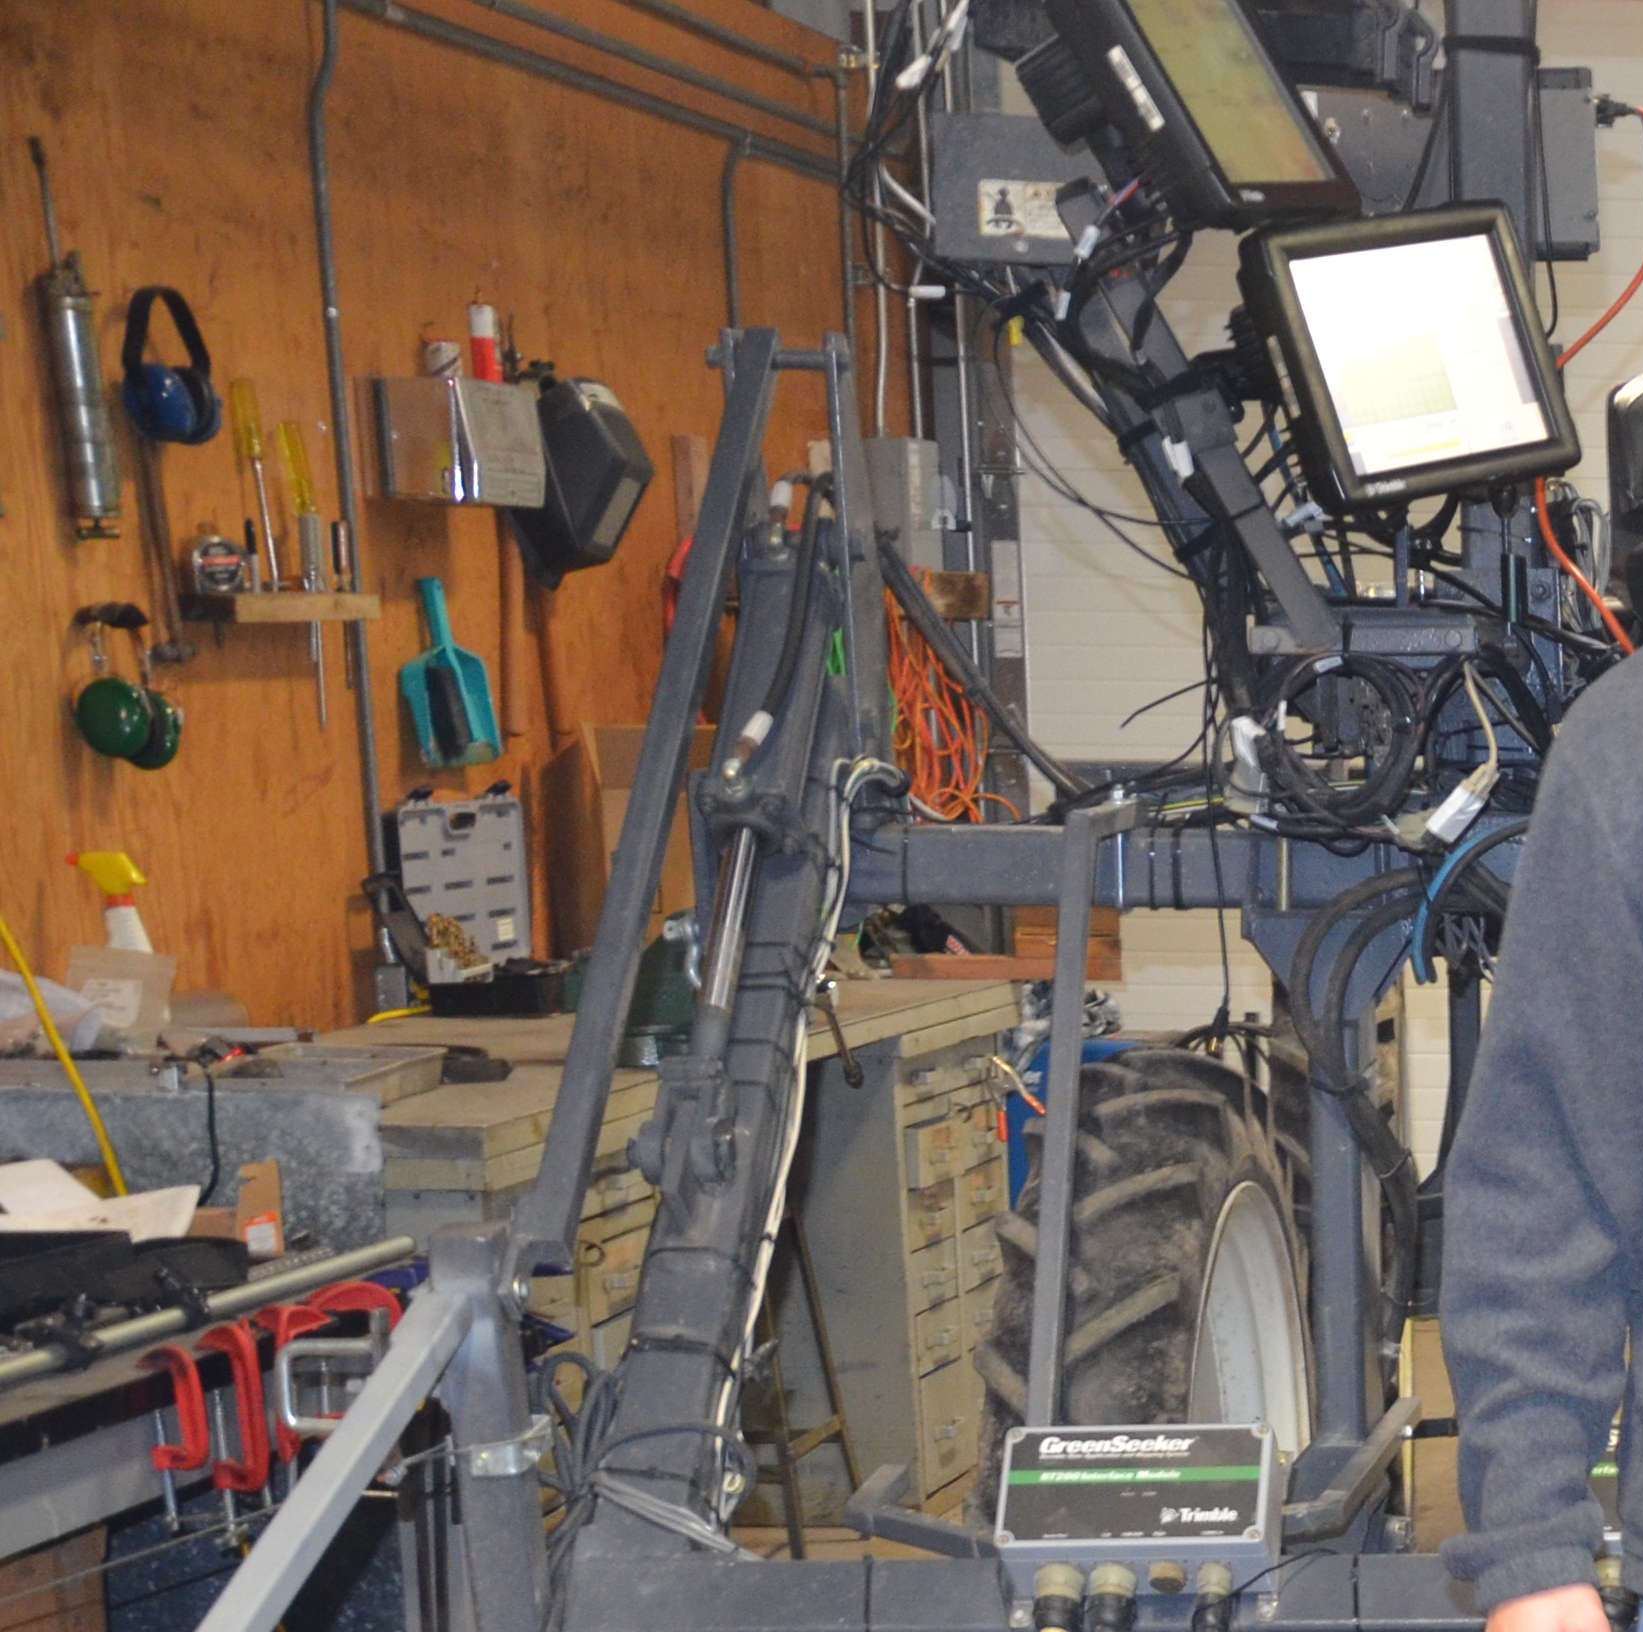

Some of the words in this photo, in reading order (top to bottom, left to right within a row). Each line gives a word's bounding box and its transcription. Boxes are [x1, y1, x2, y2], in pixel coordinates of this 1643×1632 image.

[1039, 1435, 1195, 1454] GreenSeeker
[1081, 1470, 1133, 1480] Interface
[1136, 1469, 1181, 1479] Module
[1180, 1507, 1239, 1523] Trimble
